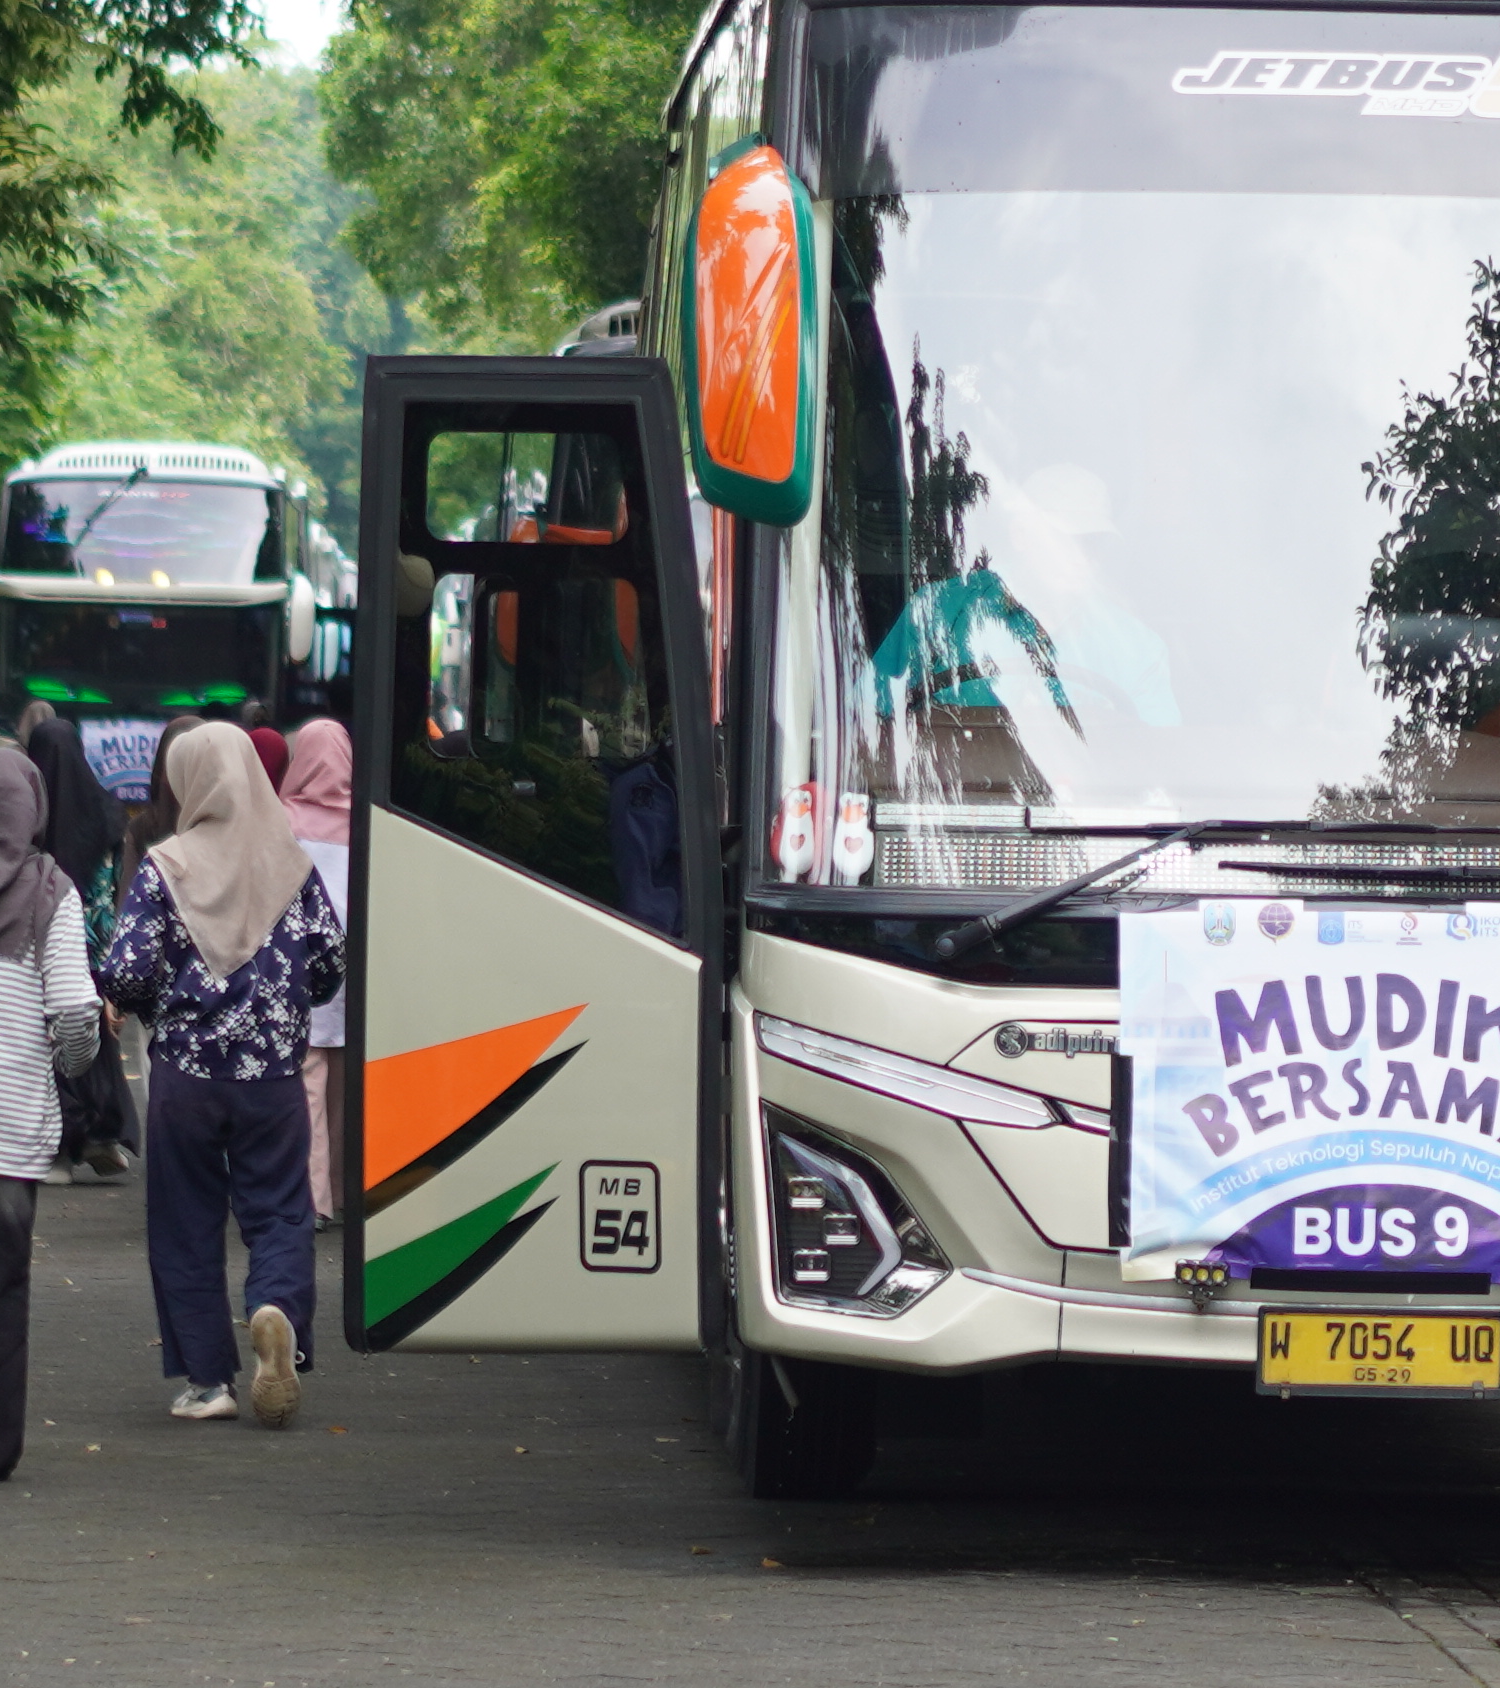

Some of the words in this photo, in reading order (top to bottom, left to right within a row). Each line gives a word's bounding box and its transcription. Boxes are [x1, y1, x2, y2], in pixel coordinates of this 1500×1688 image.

[1180, 56, 1485, 93] JETBUS
[101, 734, 160, 757] MUDI
[93, 754, 152, 777] BERSA
[116, 786, 149, 801] BUS
[1479, 927, 1499, 937] ITS
[599, 1177, 642, 1196] MB
[1189, 1165, 1260, 1212] Institut
[1263, 1138, 1365, 1176] Teknologi
[1369, 1139, 1456, 1167] Sepuluh
[592, 1209, 651, 1256] 54
[1292, 1206, 1417, 1258] BUS
[1433, 1205, 1470, 1258] 9
[1269, 1321, 1292, 1362] W
[1325, 1322, 1417, 1363] 7054
[1450, 1325, 1496, 1364] UQ
